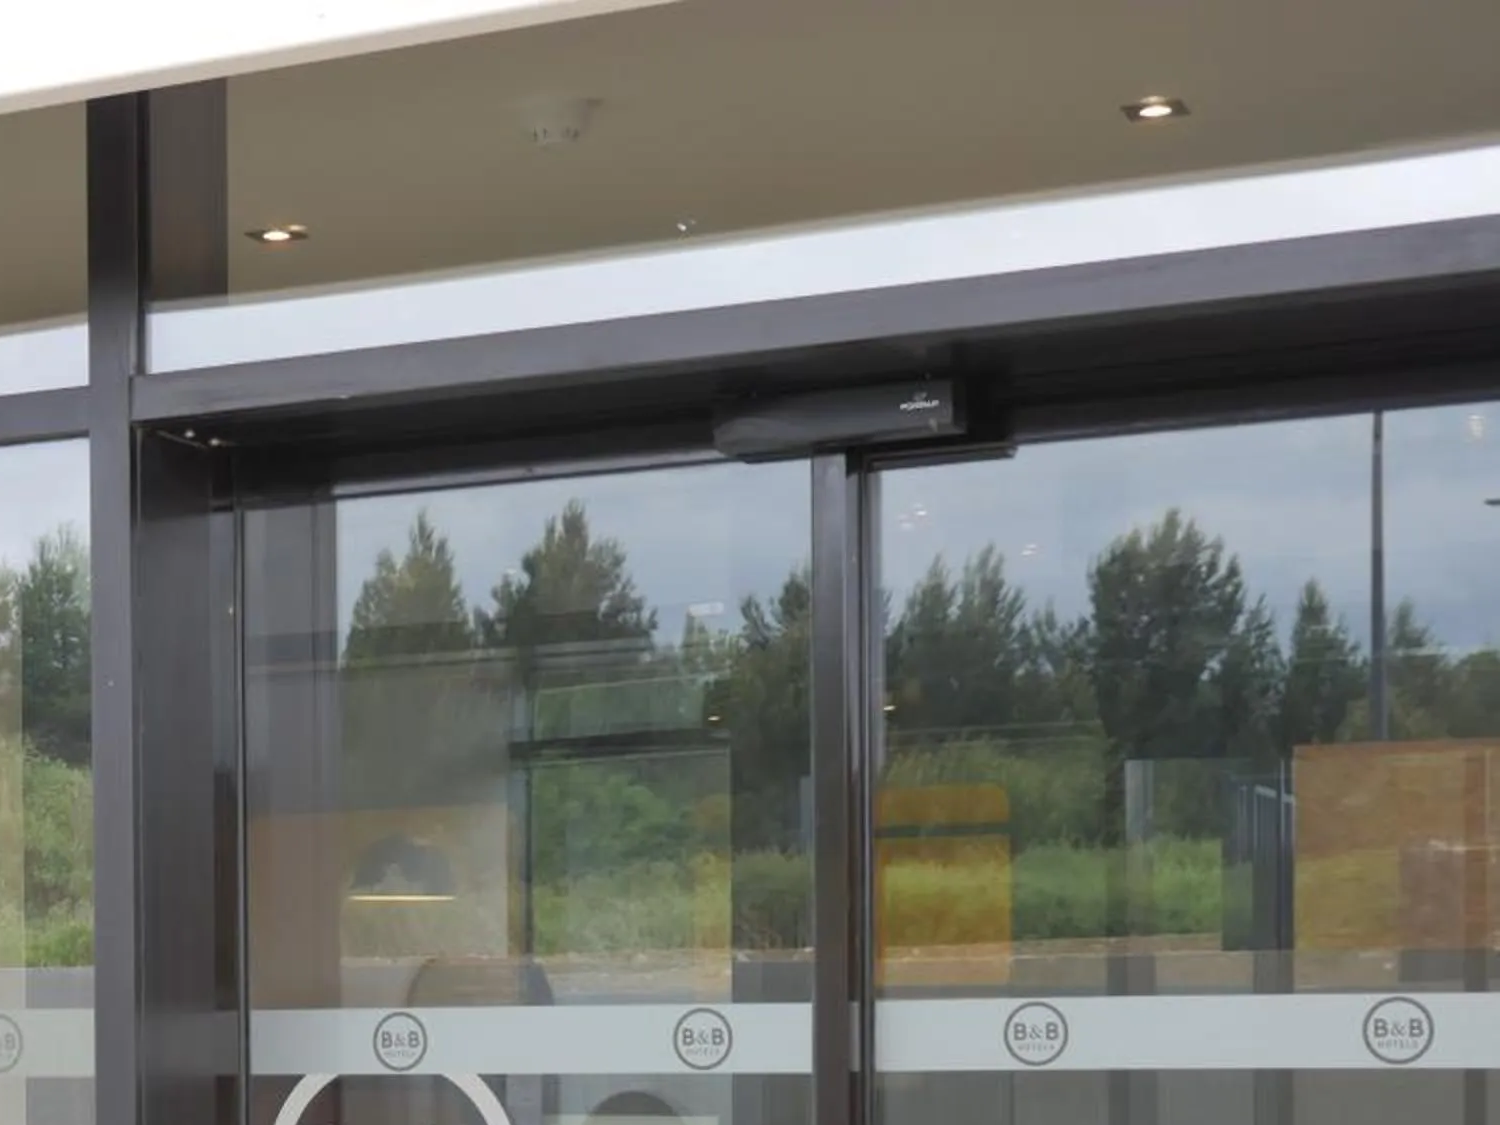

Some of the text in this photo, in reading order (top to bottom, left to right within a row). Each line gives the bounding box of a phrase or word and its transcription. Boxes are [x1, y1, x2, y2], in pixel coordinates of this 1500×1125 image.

[682, 1028, 726, 1046] B&B
[1013, 1021, 1060, 1041] B&B
[1373, 1017, 1426, 1038] B&B
[381, 1030, 421, 1049] B&B
